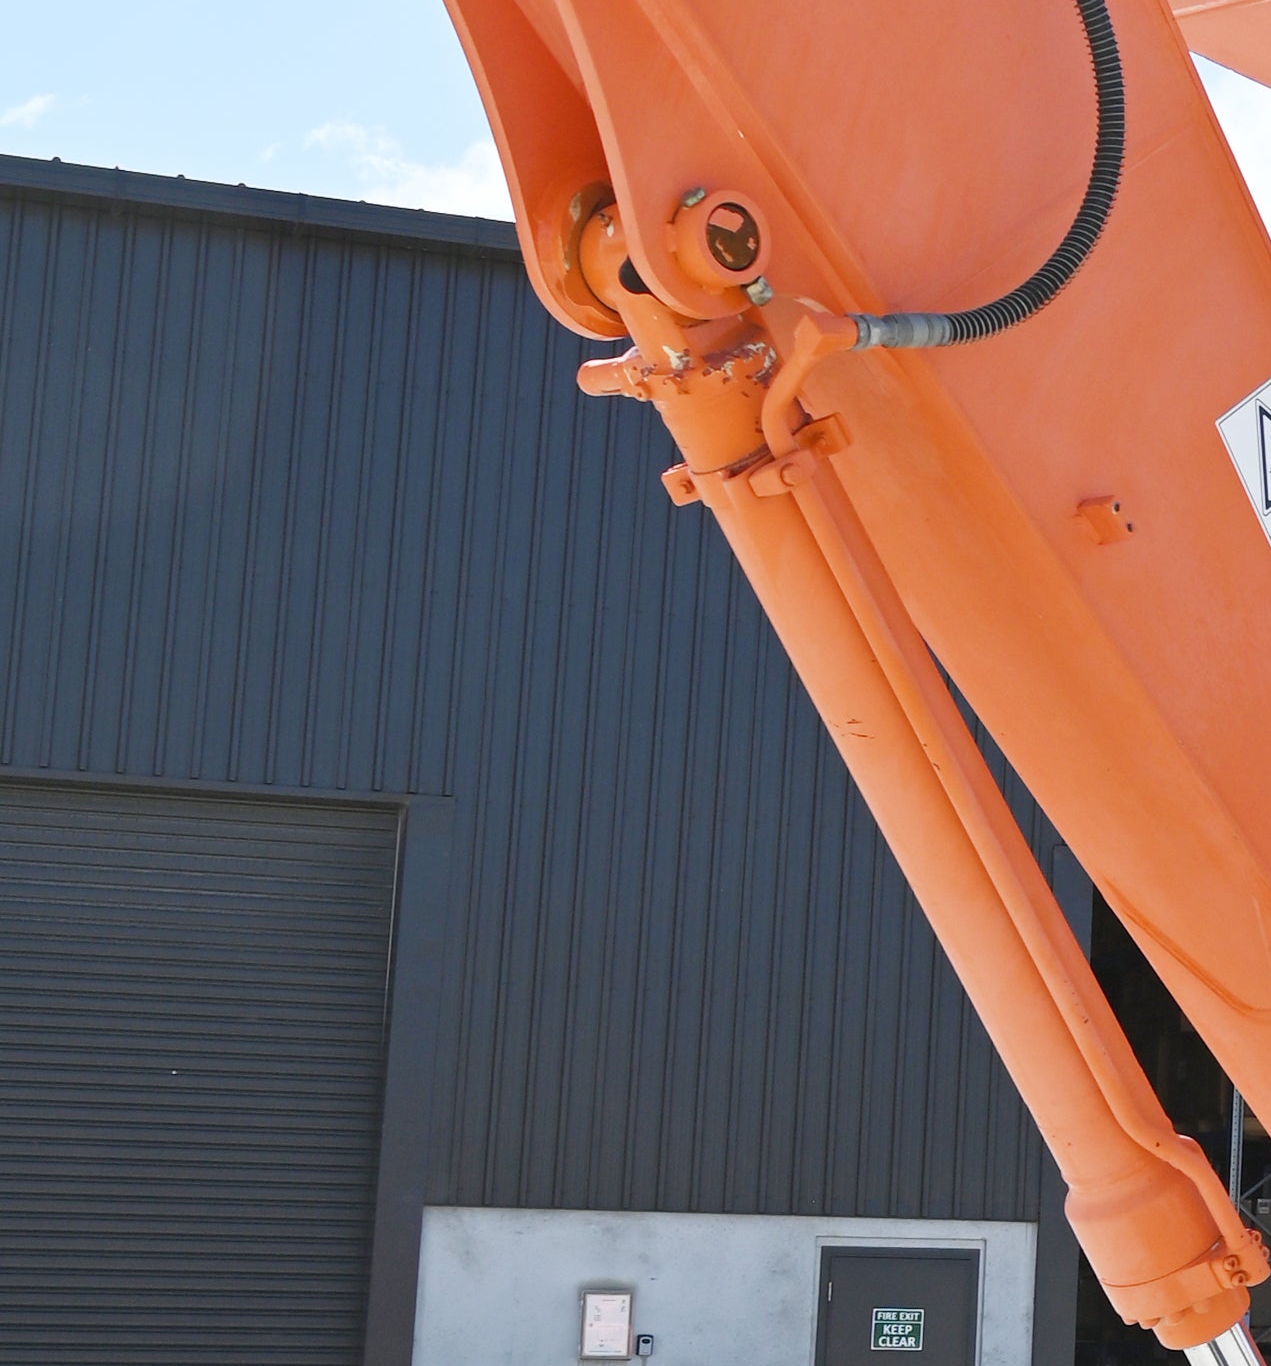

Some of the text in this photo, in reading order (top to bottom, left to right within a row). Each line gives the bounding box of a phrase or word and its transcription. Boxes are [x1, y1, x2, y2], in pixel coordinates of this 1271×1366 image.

[877, 1312, 920, 1321] FIRE EXIT
[883, 1324, 913, 1335] KEEP
[878, 1336, 916, 1347] CLEAR
